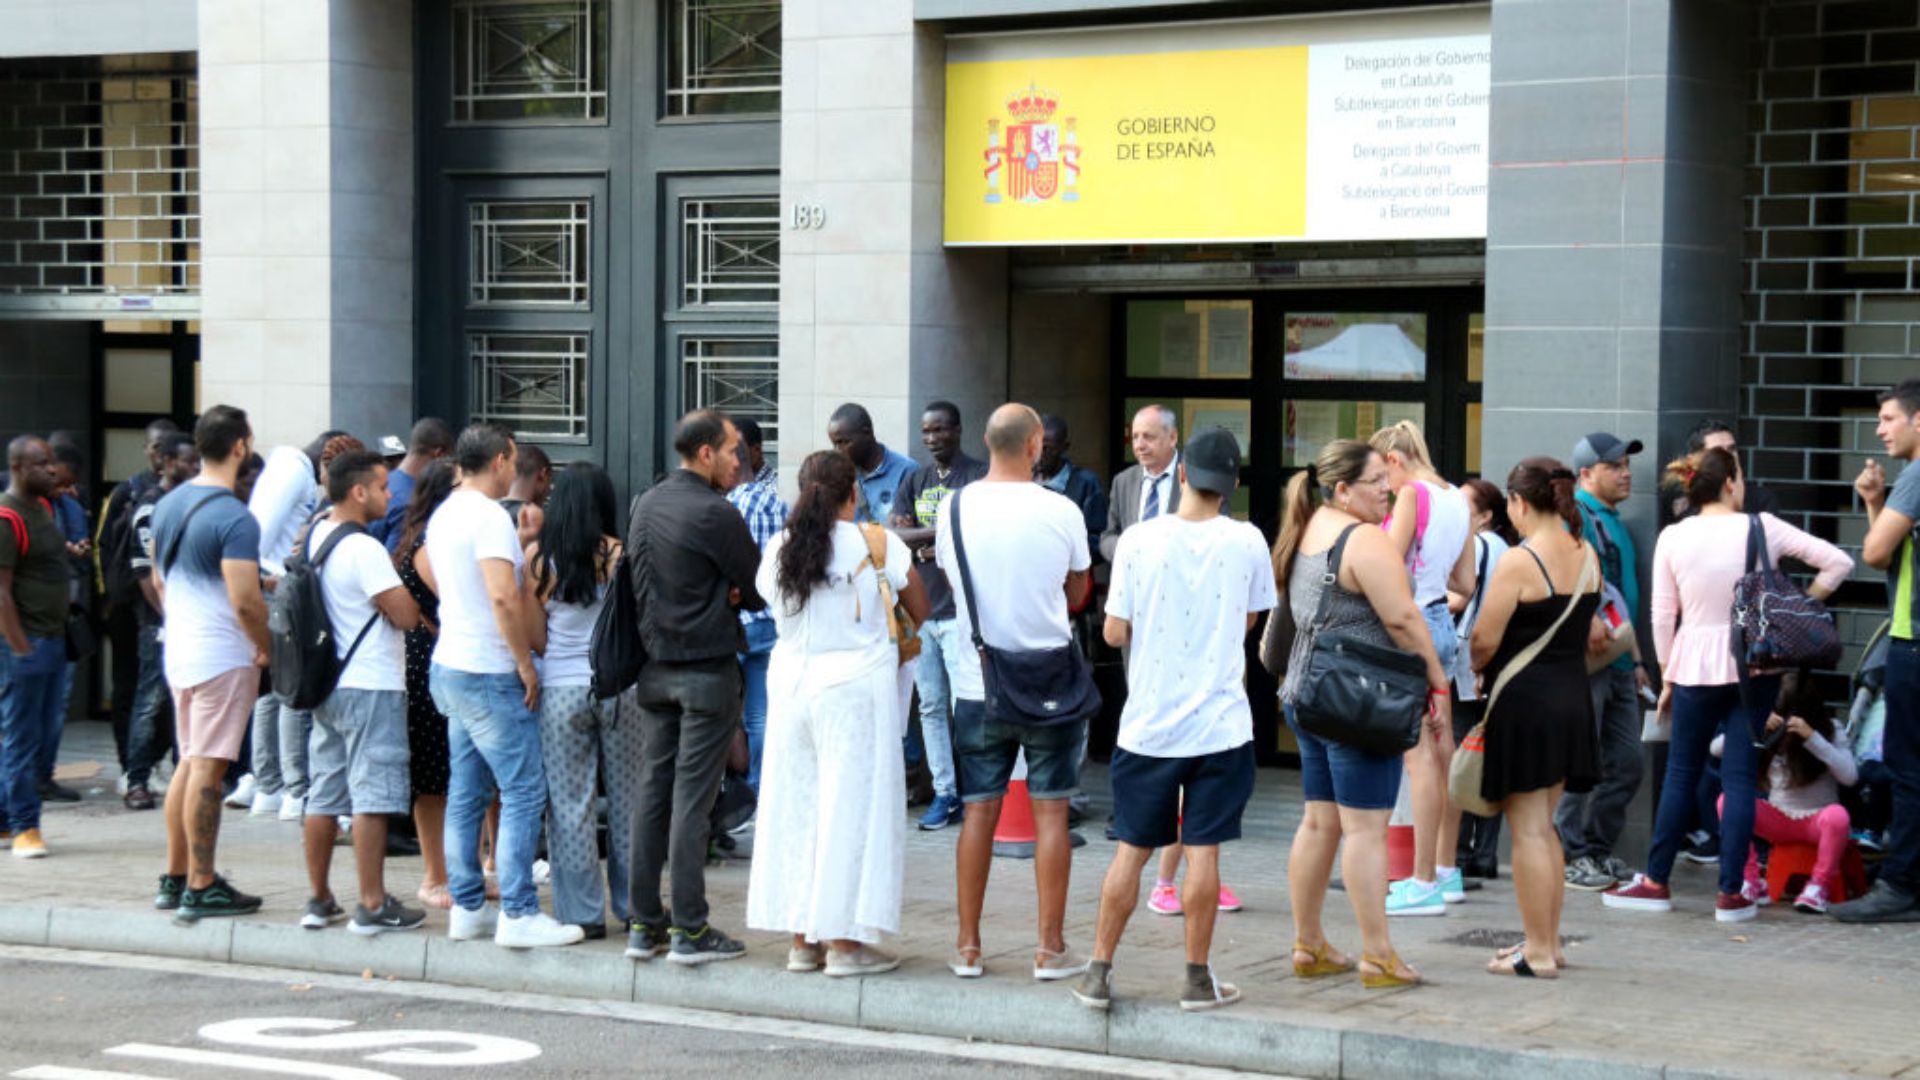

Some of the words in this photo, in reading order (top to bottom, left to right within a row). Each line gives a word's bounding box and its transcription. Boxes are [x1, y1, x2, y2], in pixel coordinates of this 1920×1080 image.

[1344, 52, 1411, 72] Delegación
[1413, 53, 1431, 66] del
[1436, 50, 1491, 66] Gobierno
[1381, 77, 1396, 88] en
[1400, 72, 1454, 88] Cataluña
[1334, 94, 1421, 113] Subdelegación
[1424, 93, 1443, 108] del
[1446, 92, 1489, 107] Gobiern
[1117, 116, 1216, 135] GOBIERNO
[1377, 118, 1392, 130] en
[1396, 114, 1457, 130] Barcelona
[1117, 143, 1140, 160] DE
[1147, 137, 1216, 160] ESPAÑA
[1415, 141, 1433, 156] del
[1379, 167, 1388, 177] a
[1391, 163, 1452, 179] Catalunya
[1424, 183, 1443, 197] del
[791, 202, 826, 230] 189
[1379, 208, 1387, 219] a
[1390, 204, 1451, 219] Barcelona
